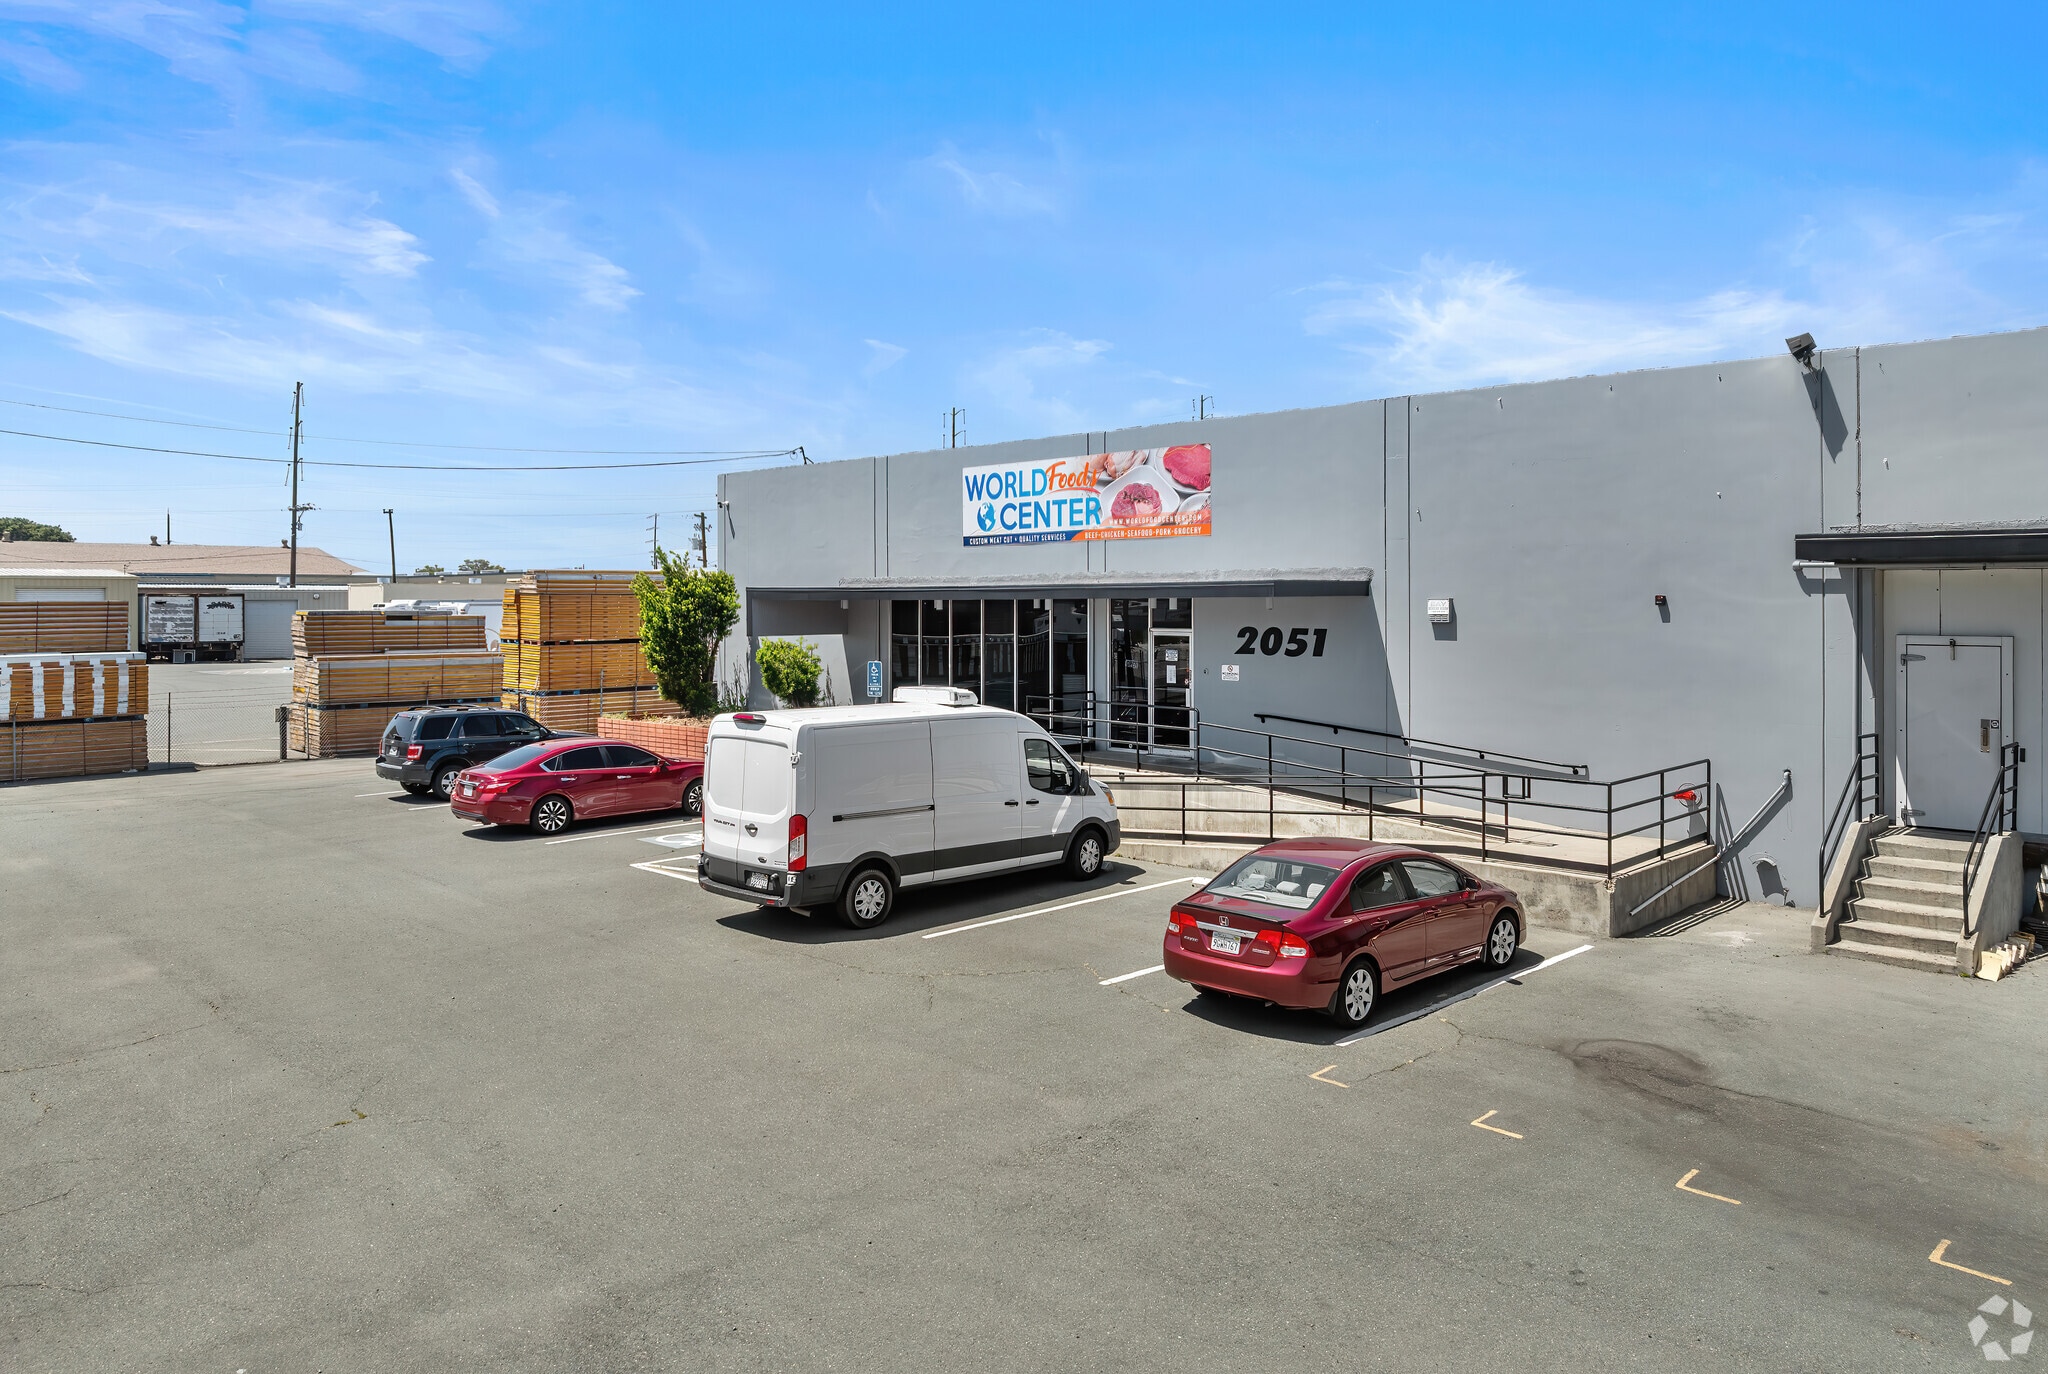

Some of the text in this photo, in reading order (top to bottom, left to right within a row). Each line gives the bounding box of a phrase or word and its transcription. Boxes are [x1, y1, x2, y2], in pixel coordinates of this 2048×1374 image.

[965, 460, 1099, 502] WORLD Foods
[999, 497, 1101, 531] CENTER
[969, 533, 1066, 545] CUSTOM MEAT CUT QUALITY SERVICES
[1233, 626, 1328, 657] 2051
